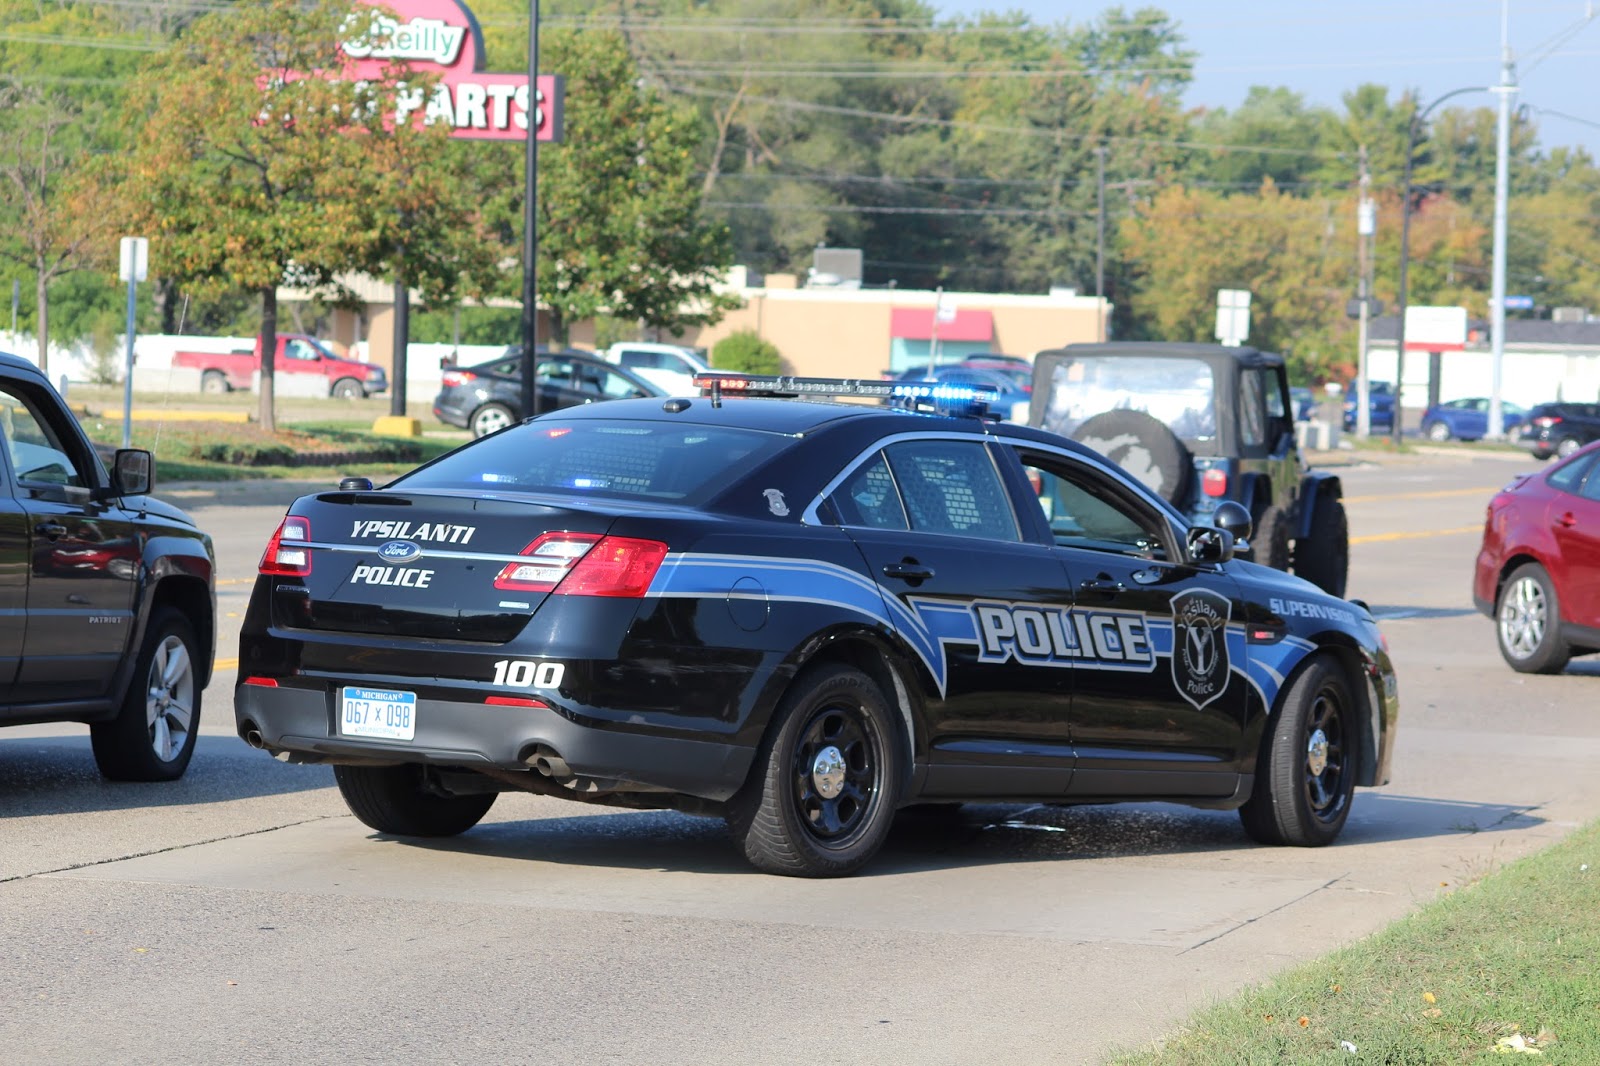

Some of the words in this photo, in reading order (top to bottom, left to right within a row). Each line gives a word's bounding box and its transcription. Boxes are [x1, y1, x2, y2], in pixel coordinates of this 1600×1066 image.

[396, 81, 545, 128] PARTS
[350, 520, 476, 545] YPSILANTI
[384, 543, 411, 556] Ford
[350, 565, 435, 589] POLICE
[89, 616, 121, 624] PATRIOT
[976, 604, 1152, 663] POLICE
[492, 660, 566, 689] 100
[361, 690, 398, 702] MICHIGAN
[1186, 680, 1214, 695] Police
[345, 701, 370, 724] 067
[374, 707, 382, 721] X
[386, 704, 410, 728] 098
